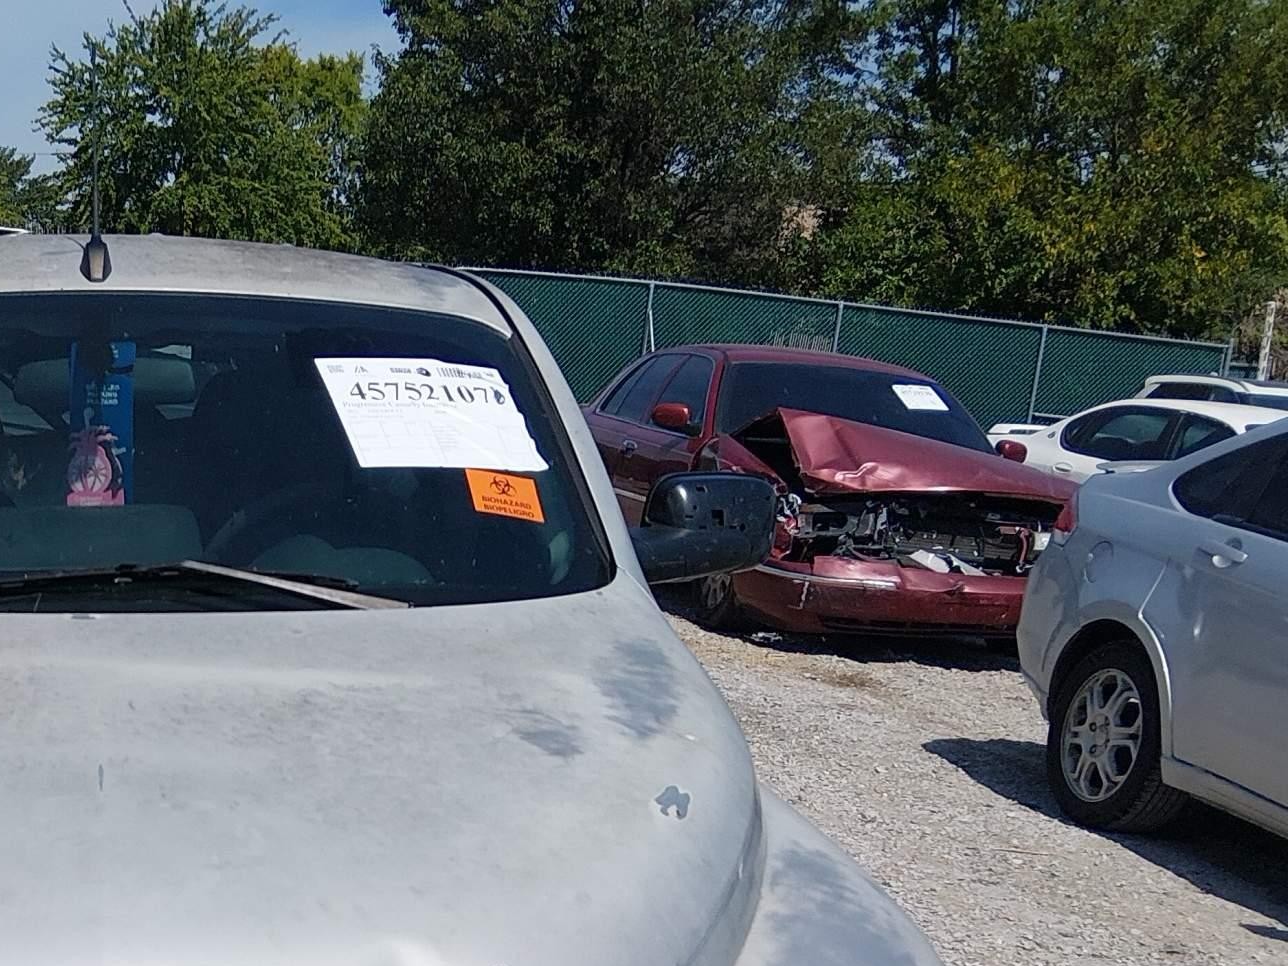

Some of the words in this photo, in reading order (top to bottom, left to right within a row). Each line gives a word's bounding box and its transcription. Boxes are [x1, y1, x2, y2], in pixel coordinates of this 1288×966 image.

[350, 381, 489, 404] 45752107
[481, 495, 533, 510] BIOHAZARD
[483, 503, 535, 518] BIOPELIGRO
